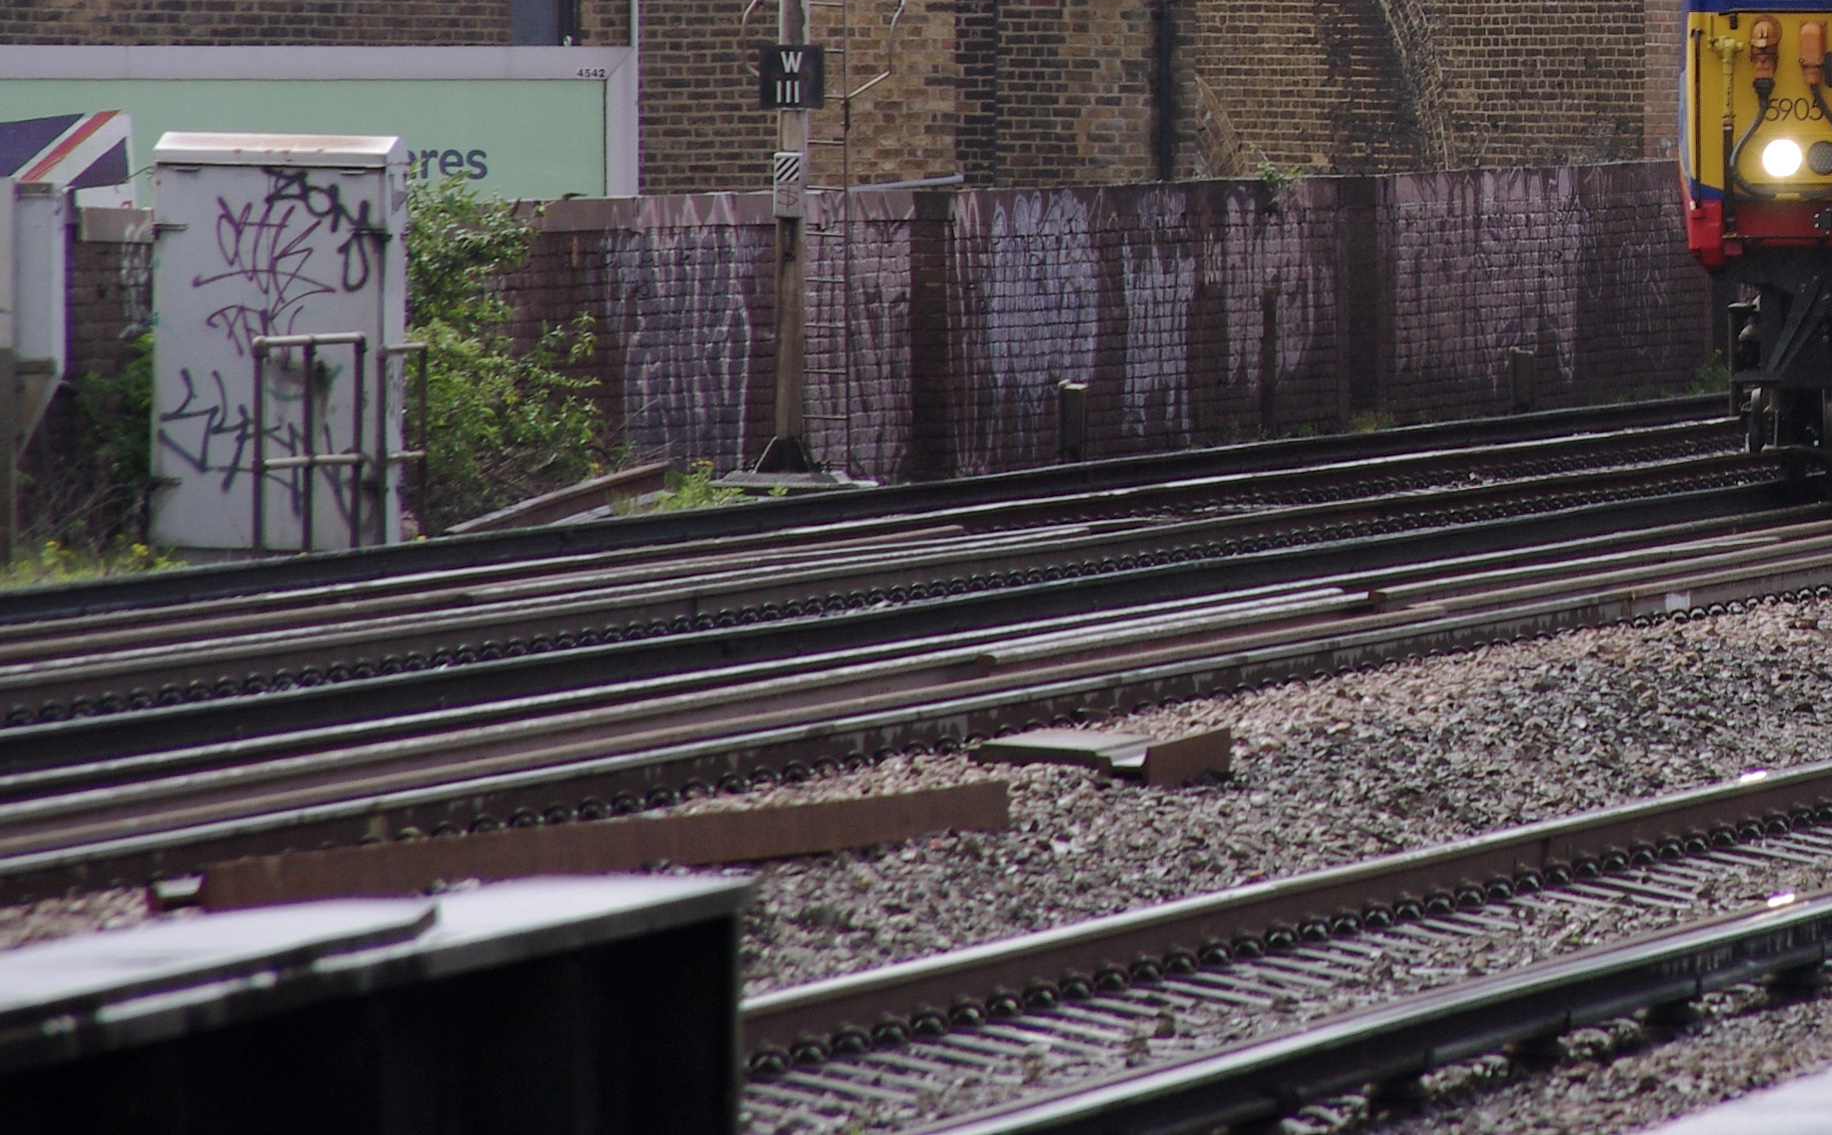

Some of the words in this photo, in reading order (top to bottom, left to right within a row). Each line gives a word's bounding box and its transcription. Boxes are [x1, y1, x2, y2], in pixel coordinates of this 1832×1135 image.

[780, 51, 803, 73] W
[577, 69, 606, 78] 4542
[1765, 98, 1825, 121] 5905
